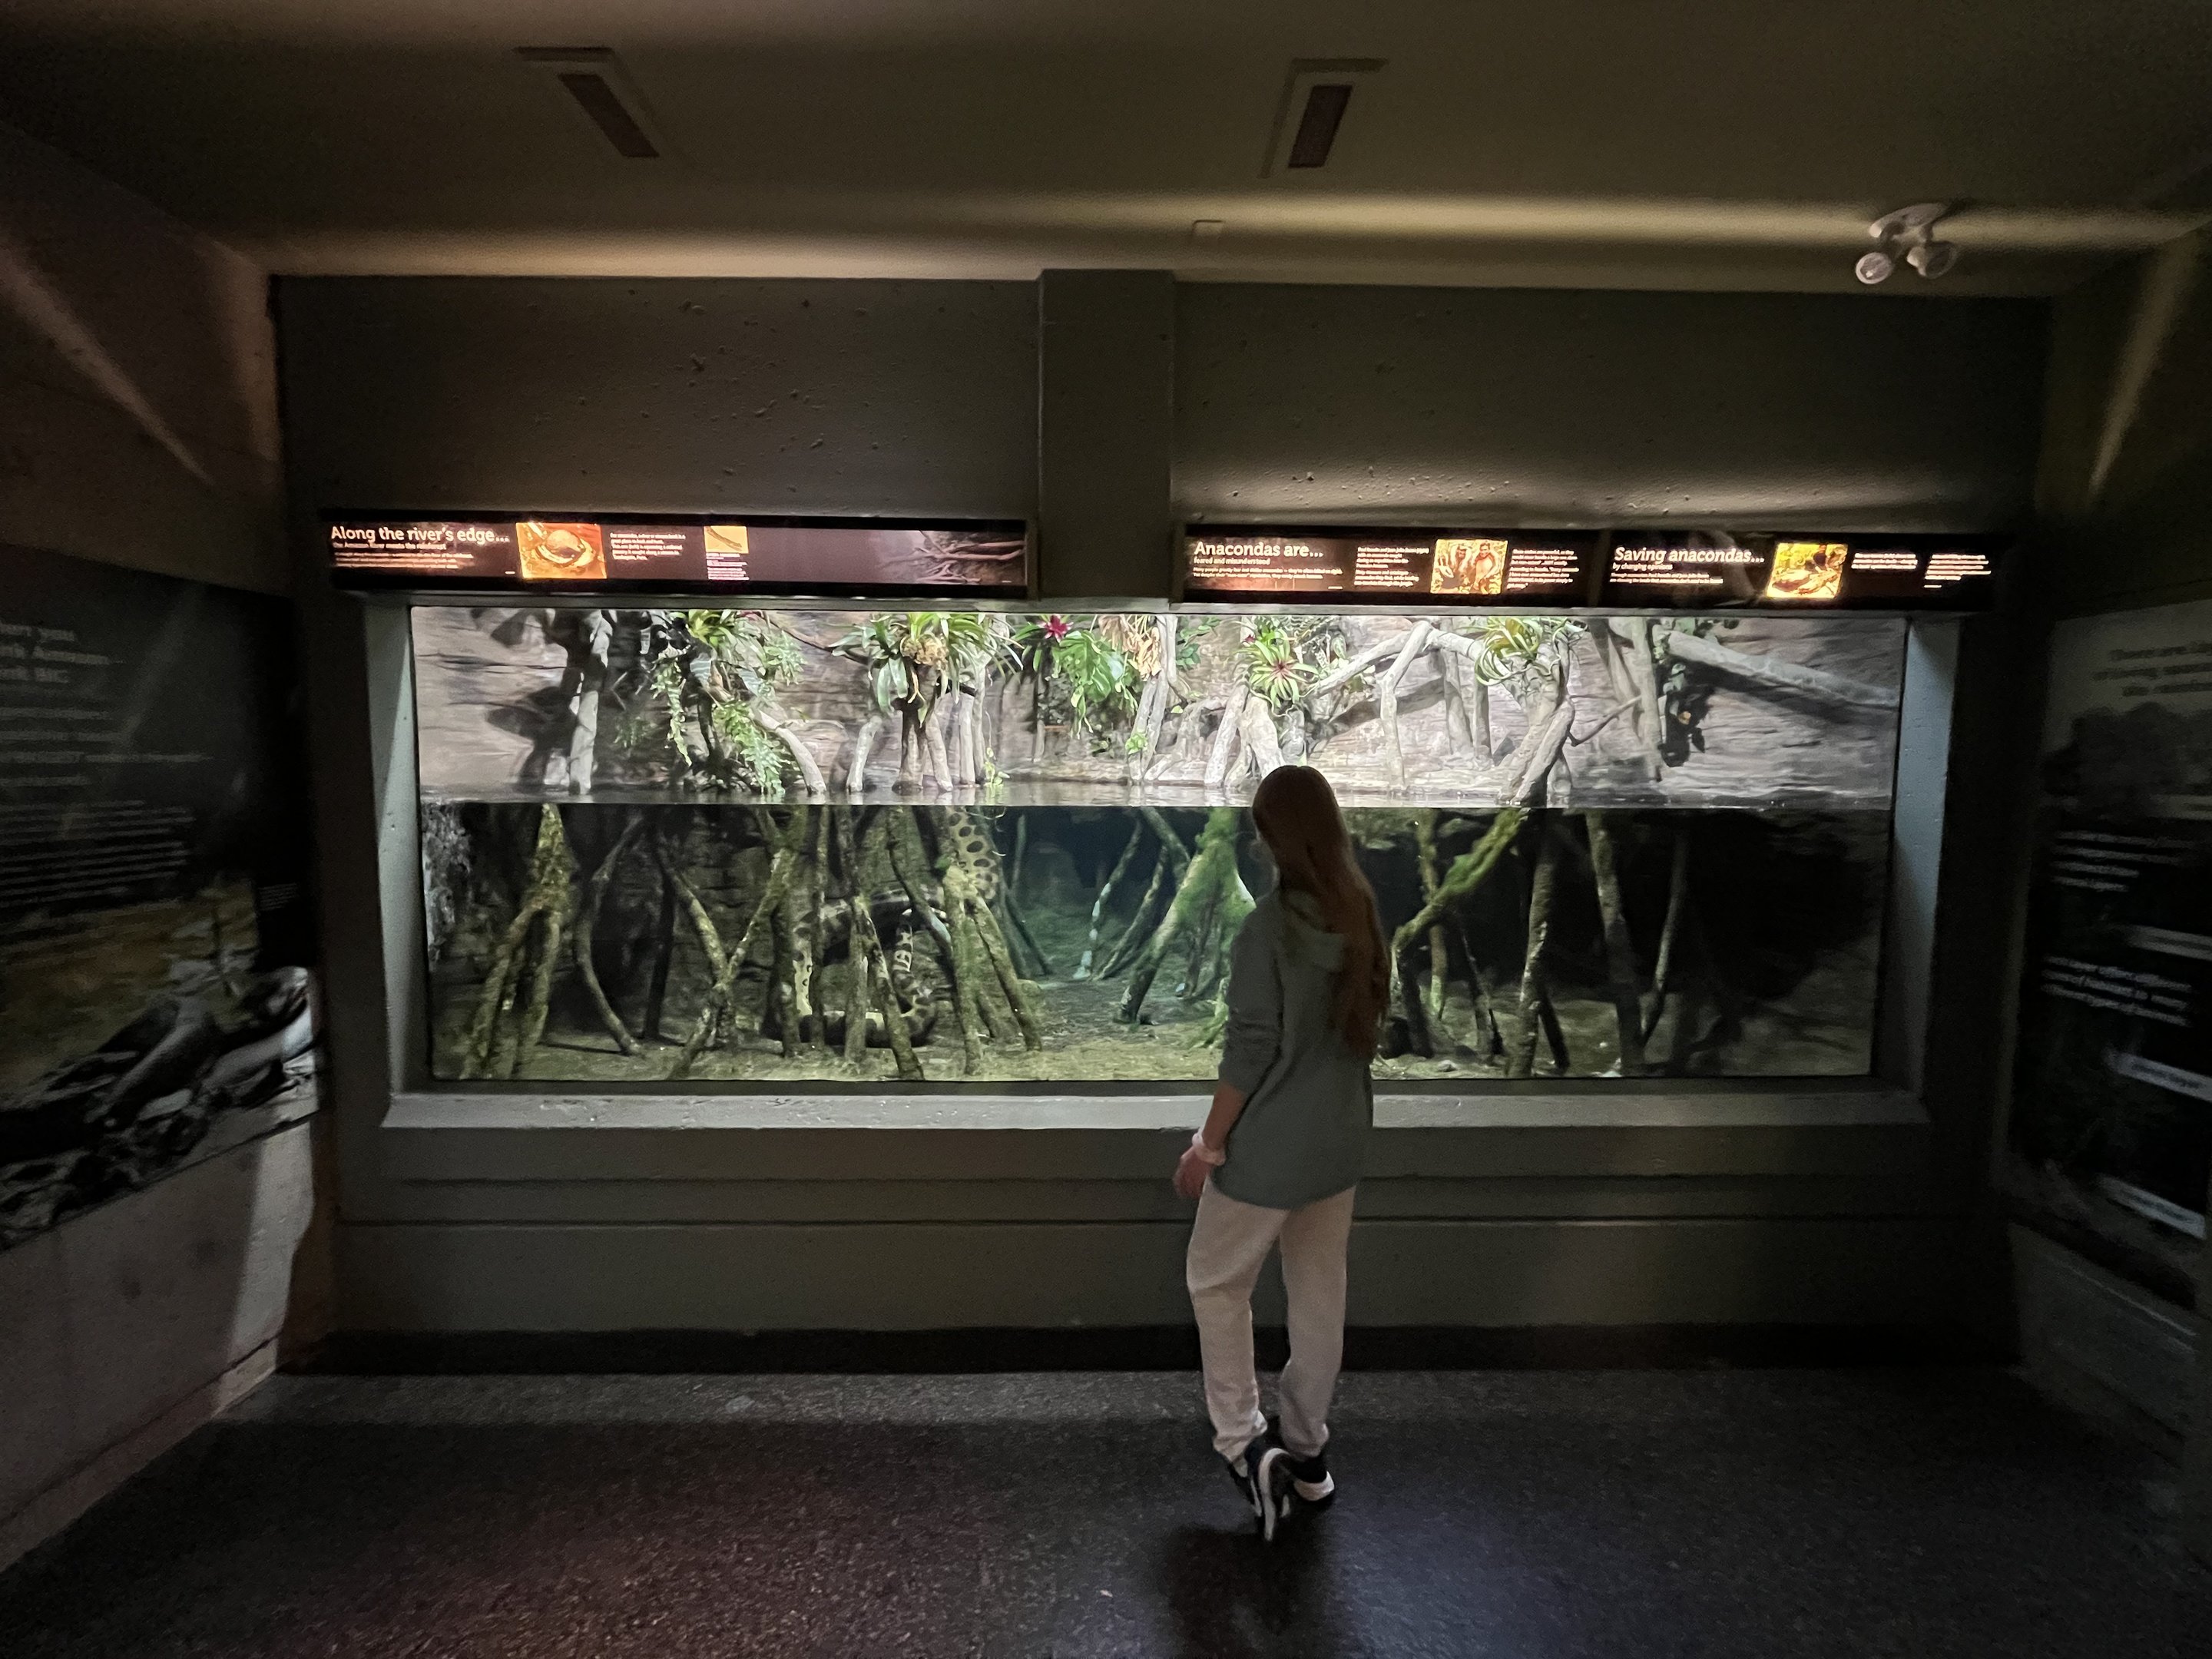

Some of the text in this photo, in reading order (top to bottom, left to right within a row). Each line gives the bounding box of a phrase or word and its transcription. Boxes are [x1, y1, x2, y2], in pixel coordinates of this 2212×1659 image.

[331, 526, 509, 545] Along the river's edge...
[1194, 541, 1323, 558] Anacondas are...
[1614, 547, 1764, 564] Saving anacondas...
